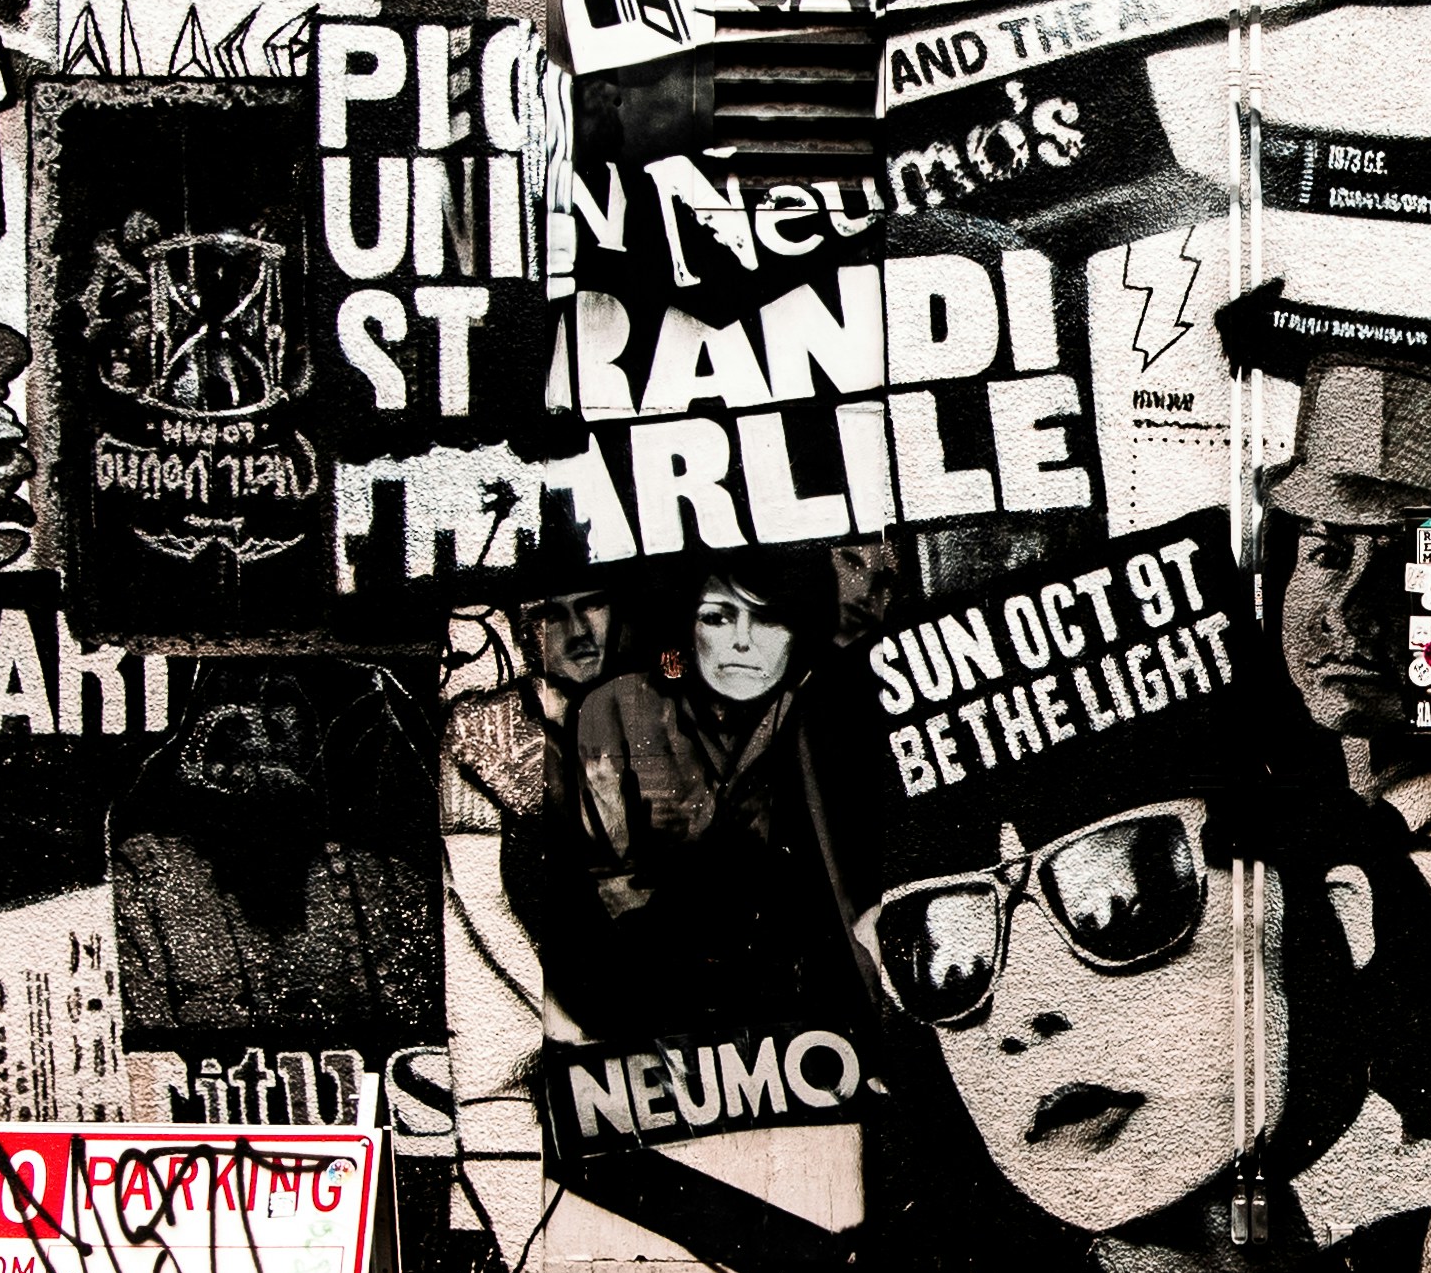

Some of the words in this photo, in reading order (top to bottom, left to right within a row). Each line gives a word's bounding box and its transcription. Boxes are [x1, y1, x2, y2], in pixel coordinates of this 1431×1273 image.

[890, 30, 989, 96] AND
[868, 606, 1003, 719] SUN
[1007, 564, 1120, 657] OCT
[889, 712, 962, 799] BE
[962, 671, 1077, 770] THE
[1084, 610, 1237, 733] LIGHT
[570, 1029, 889, 1139] NEUMO
[83, 1155, 345, 1214] PARKING
